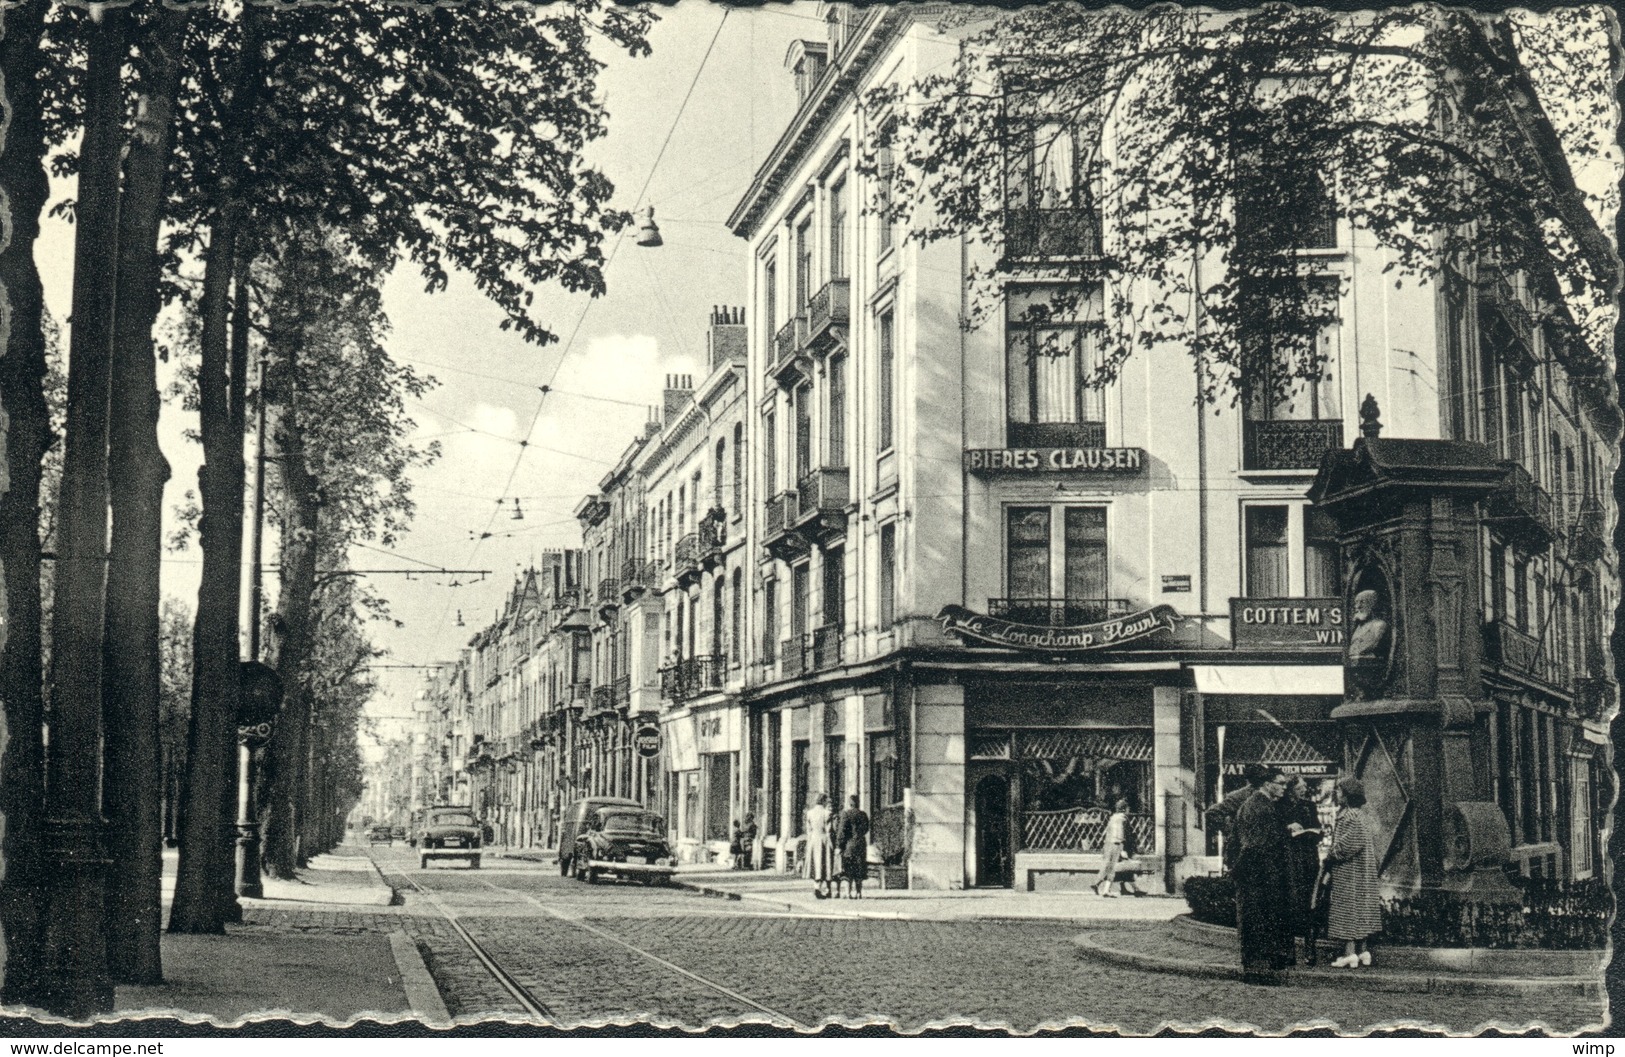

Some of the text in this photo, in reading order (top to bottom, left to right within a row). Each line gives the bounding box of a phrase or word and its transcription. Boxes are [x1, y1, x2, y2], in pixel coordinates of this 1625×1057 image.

[971, 449, 1140, 469] BIERES CLAUSEN
[1243, 607, 1342, 624] COTTEM'S
[956, 612, 1160, 648] Le Longchamp Fleuri
[1301, 765, 1328, 773] WHISKY
